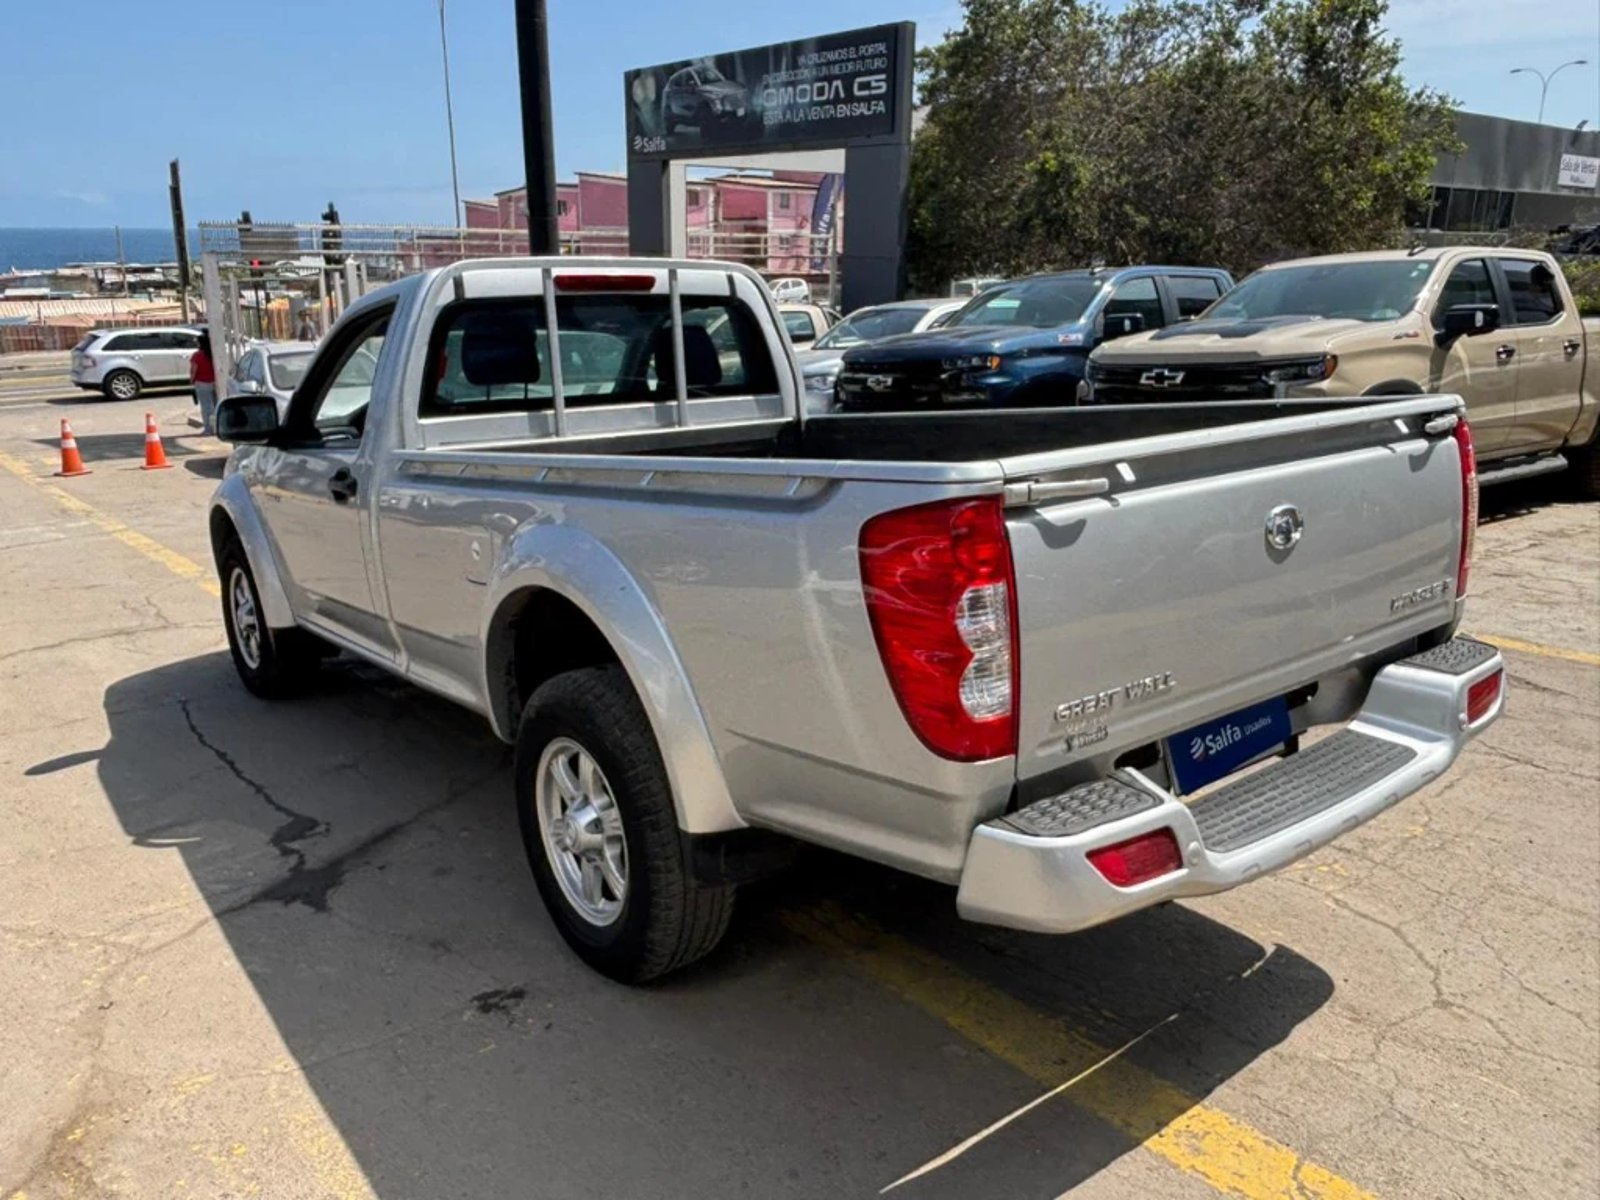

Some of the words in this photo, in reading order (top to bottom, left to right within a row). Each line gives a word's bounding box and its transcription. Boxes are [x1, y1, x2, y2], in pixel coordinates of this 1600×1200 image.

[859, 42, 888, 56] PORTAL
[856, 57, 888, 72] FUTURO
[763, 79, 845, 108] OMODA
[853, 74, 888, 96] C5
[851, 100, 886, 117] SALFA
[643, 135, 667, 153] Salfa
[1053, 687, 1121, 720] GREAT
[1124, 671, 1177, 701] WALL
[1205, 723, 1242, 755] Salfa
[1243, 716, 1272, 736] Usados
